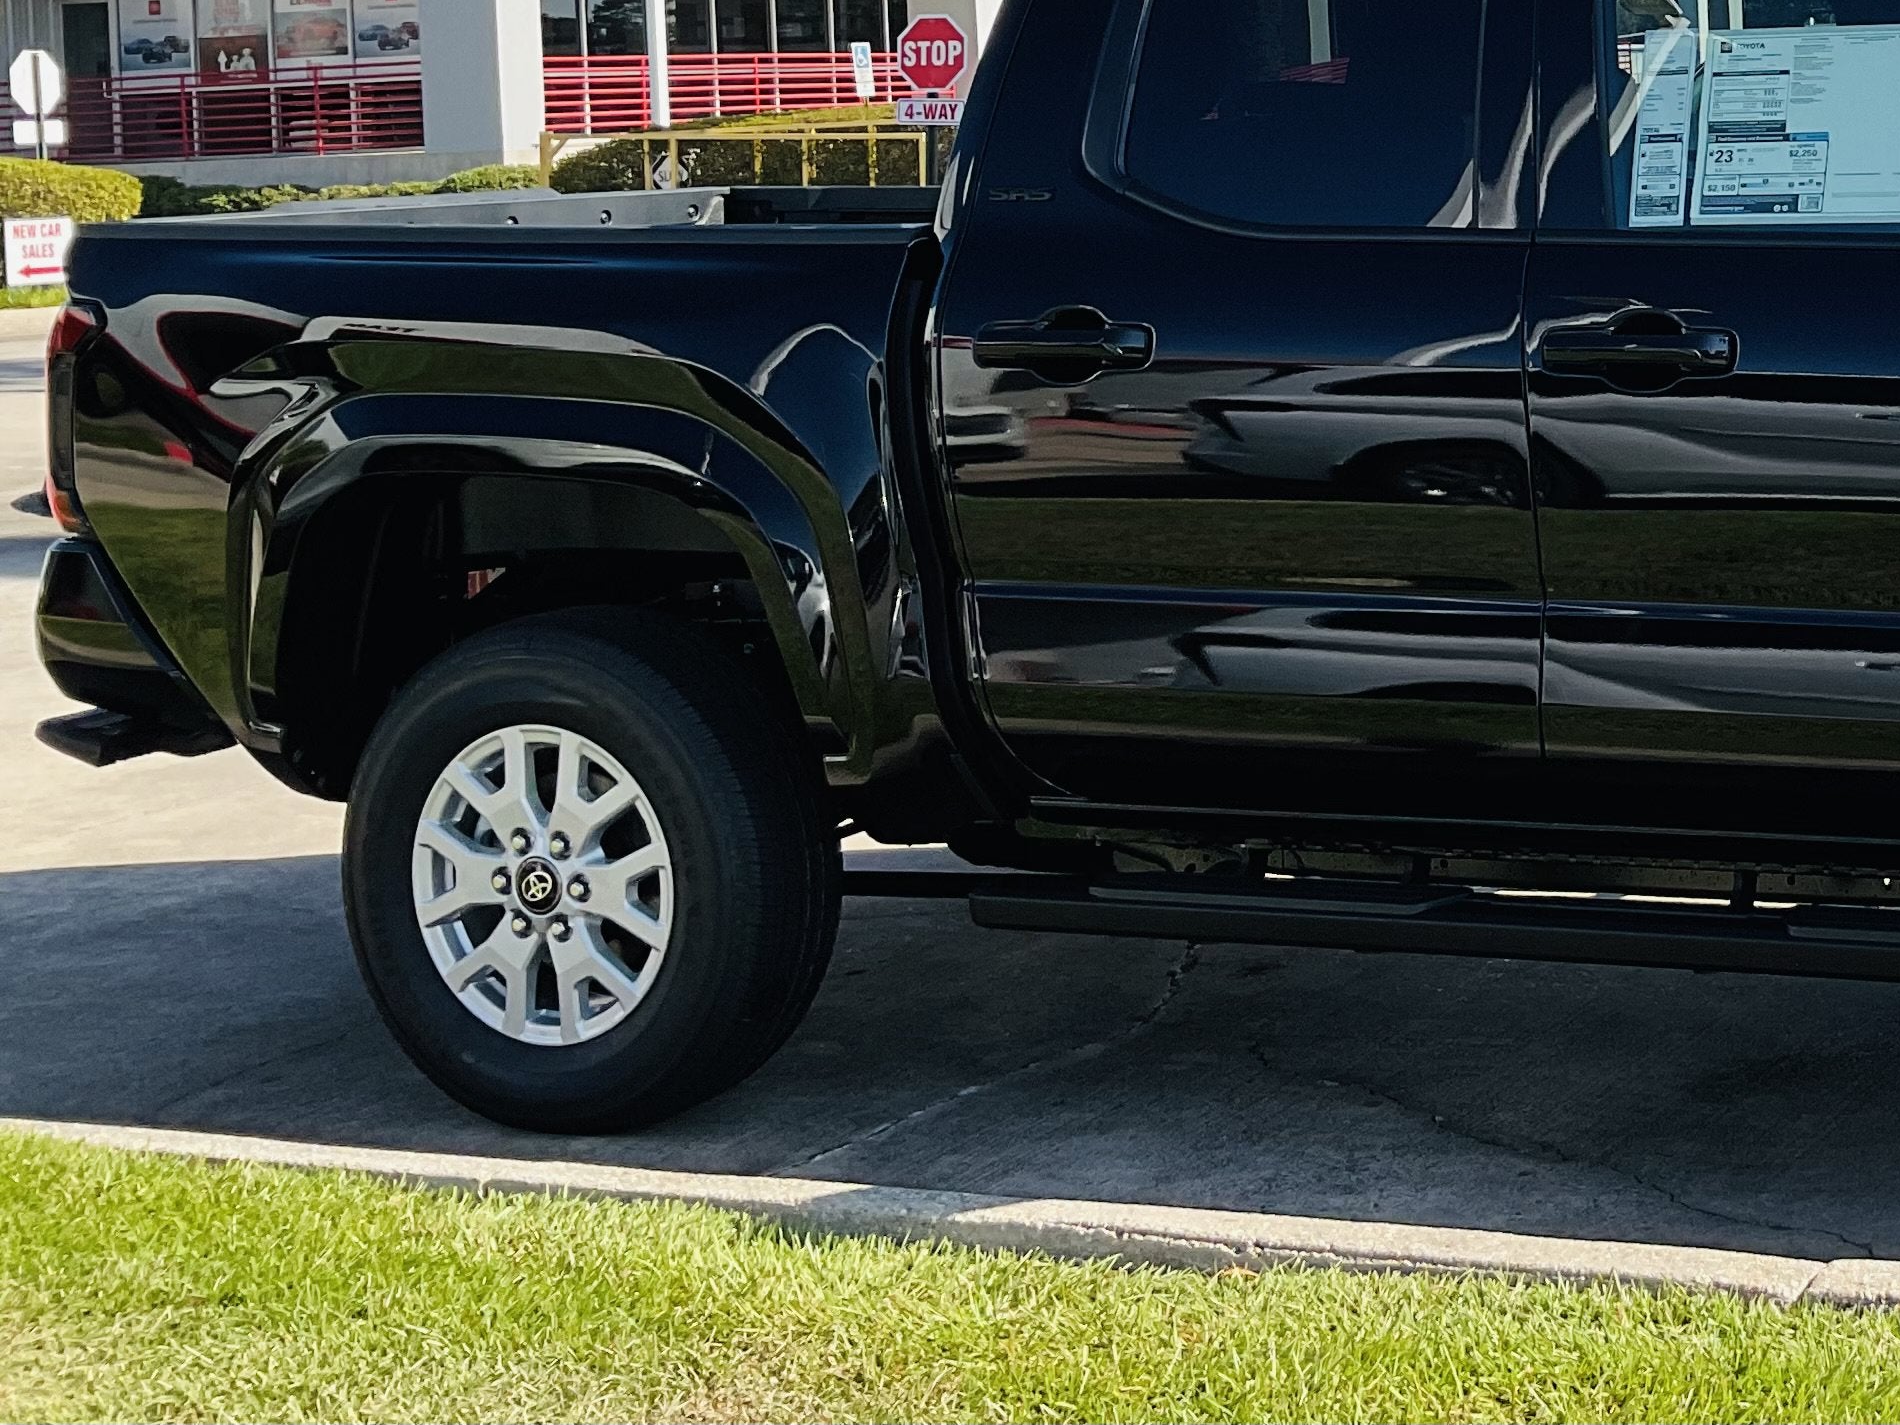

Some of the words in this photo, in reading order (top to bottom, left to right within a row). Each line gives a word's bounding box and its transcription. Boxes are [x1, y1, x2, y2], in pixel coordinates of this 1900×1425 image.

[903, 40, 962, 66] STOP
[904, 103, 958, 120] 4-WAY
[1714, 150, 1733, 163] 23
[13, 225, 36, 238] NEW
[40, 223, 61, 237] CAR
[22, 244, 54, 259] SALES
